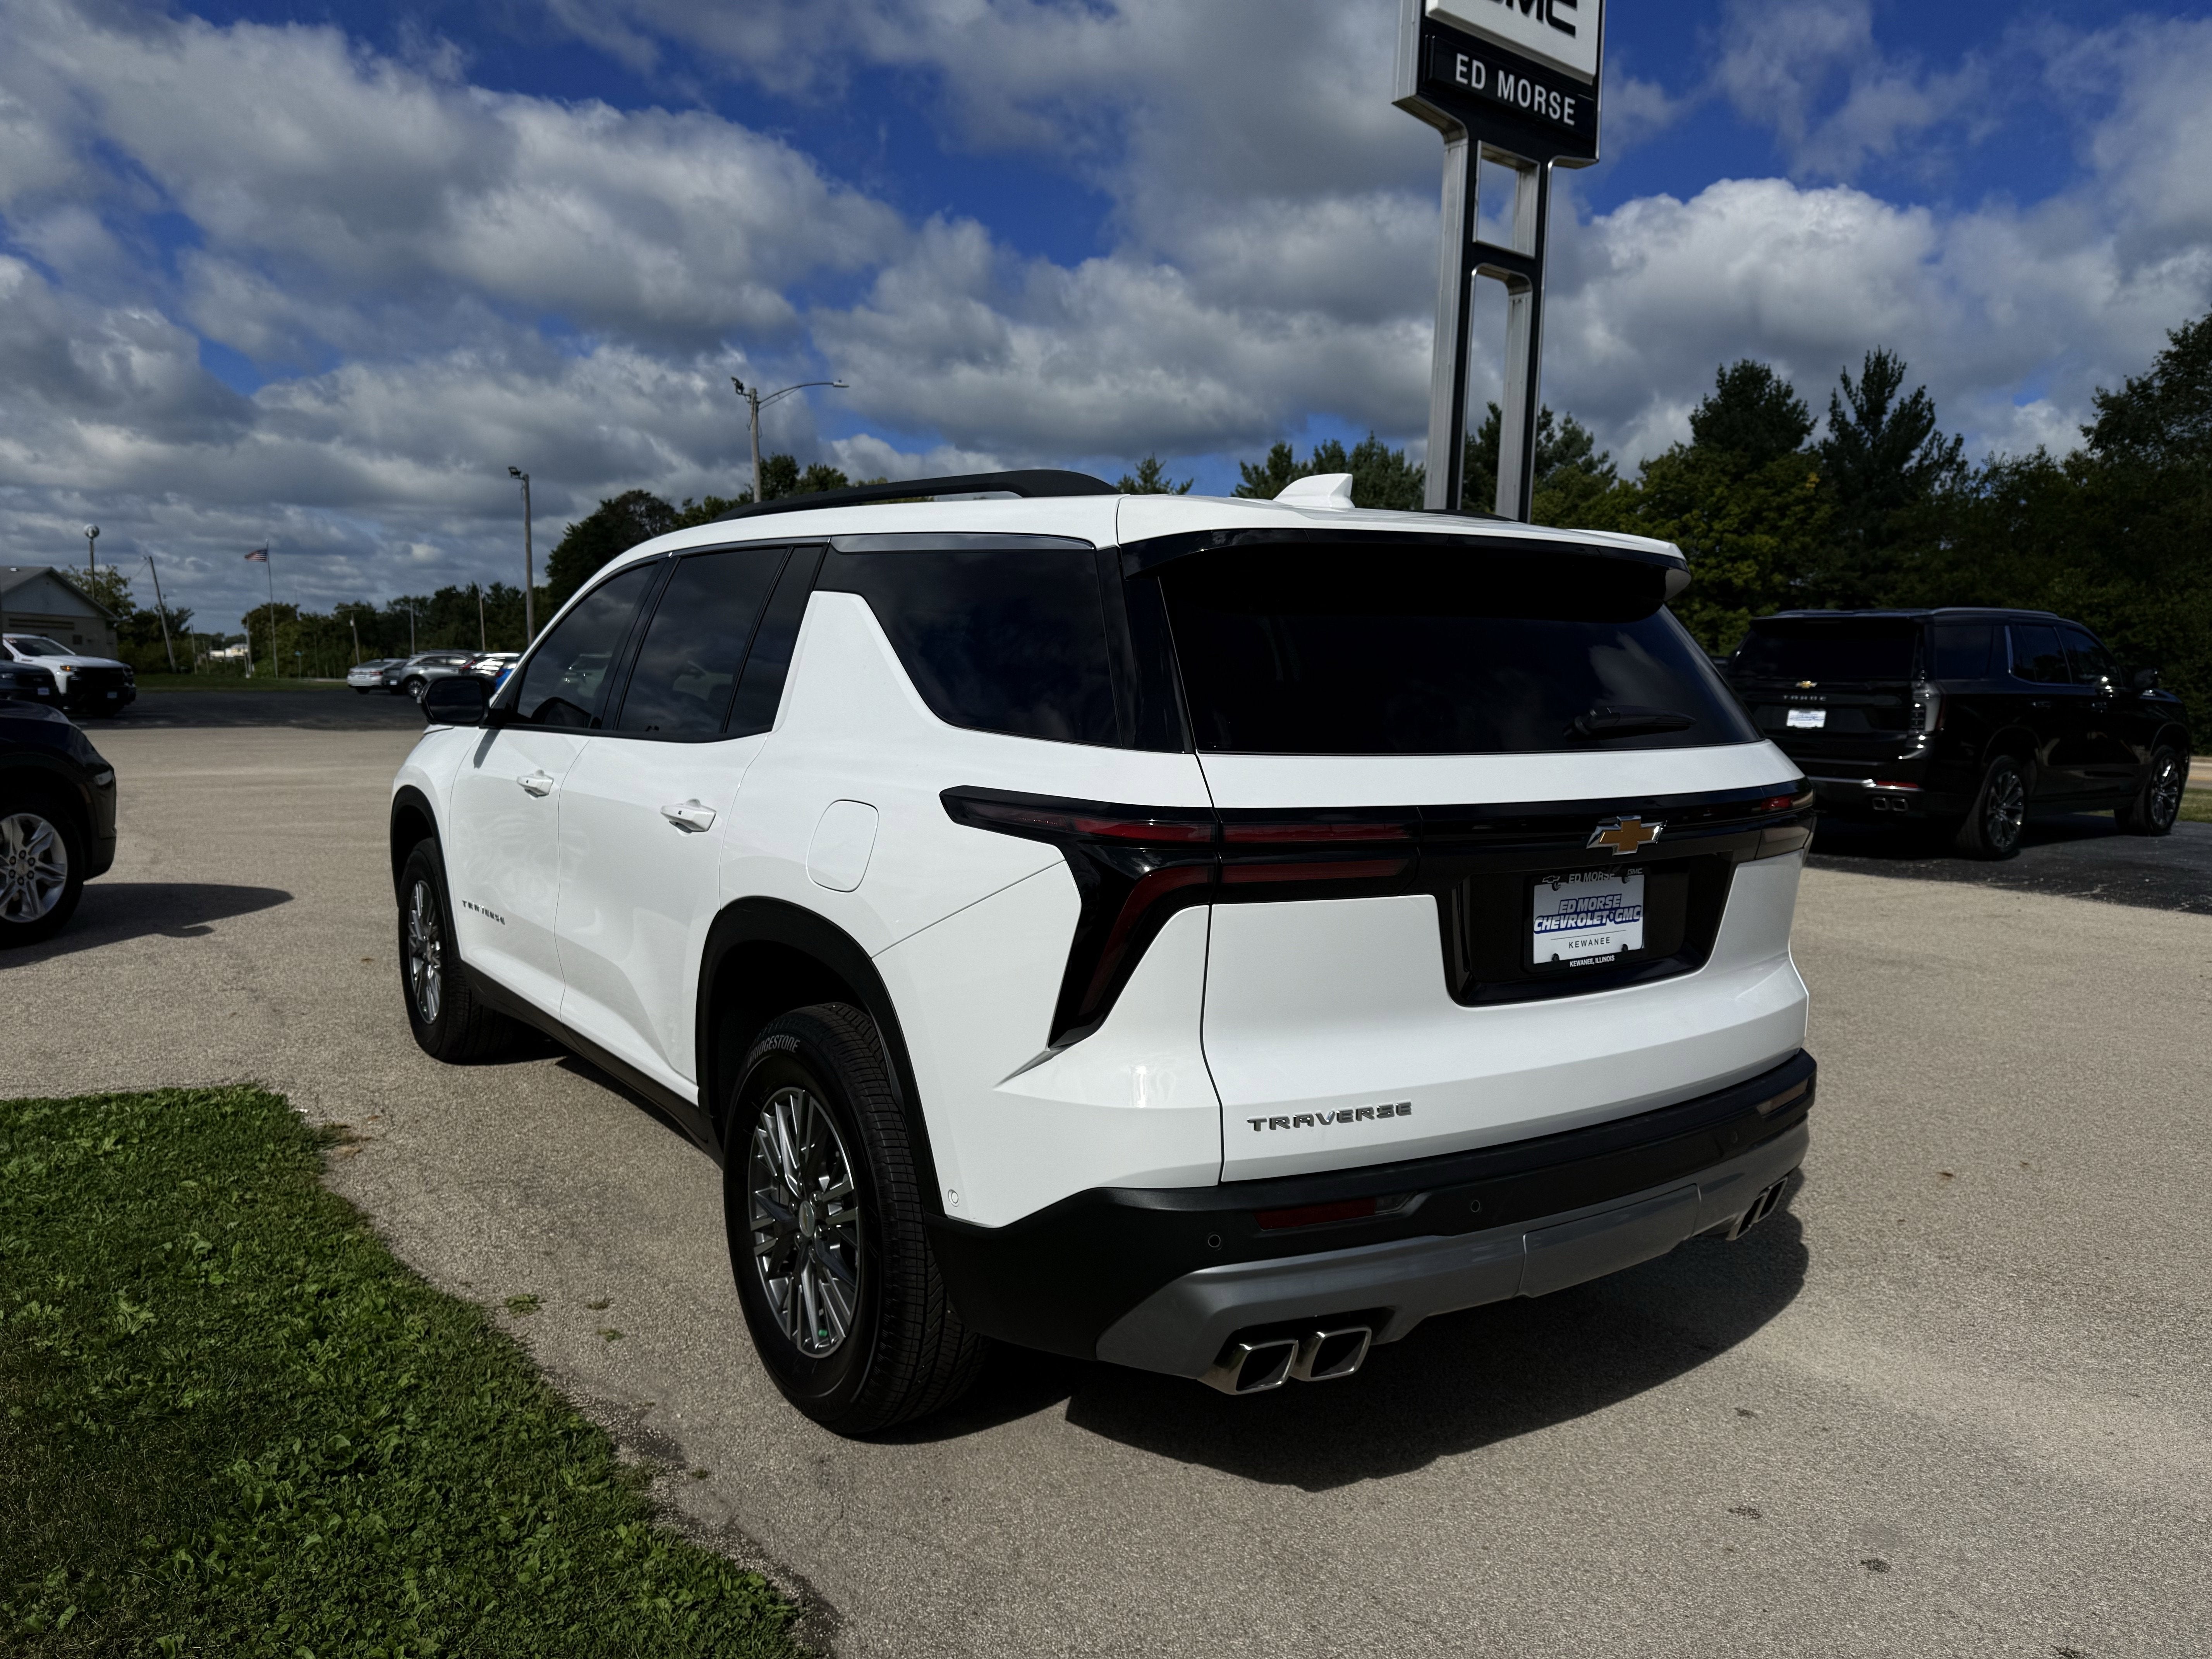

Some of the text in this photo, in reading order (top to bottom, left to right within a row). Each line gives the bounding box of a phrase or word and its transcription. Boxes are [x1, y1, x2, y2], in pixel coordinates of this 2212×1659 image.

[1455, 53, 1576, 126] ED MORSE
[1568, 873, 1581, 883] ED
[1558, 894, 1622, 914] ED MORSE
[1569, 937, 1610, 949] KEWANEE
[1570, 955, 1615, 967] KEWANEE, ILLINOIS
[1246, 1100, 1412, 1132] TRAVERSE
